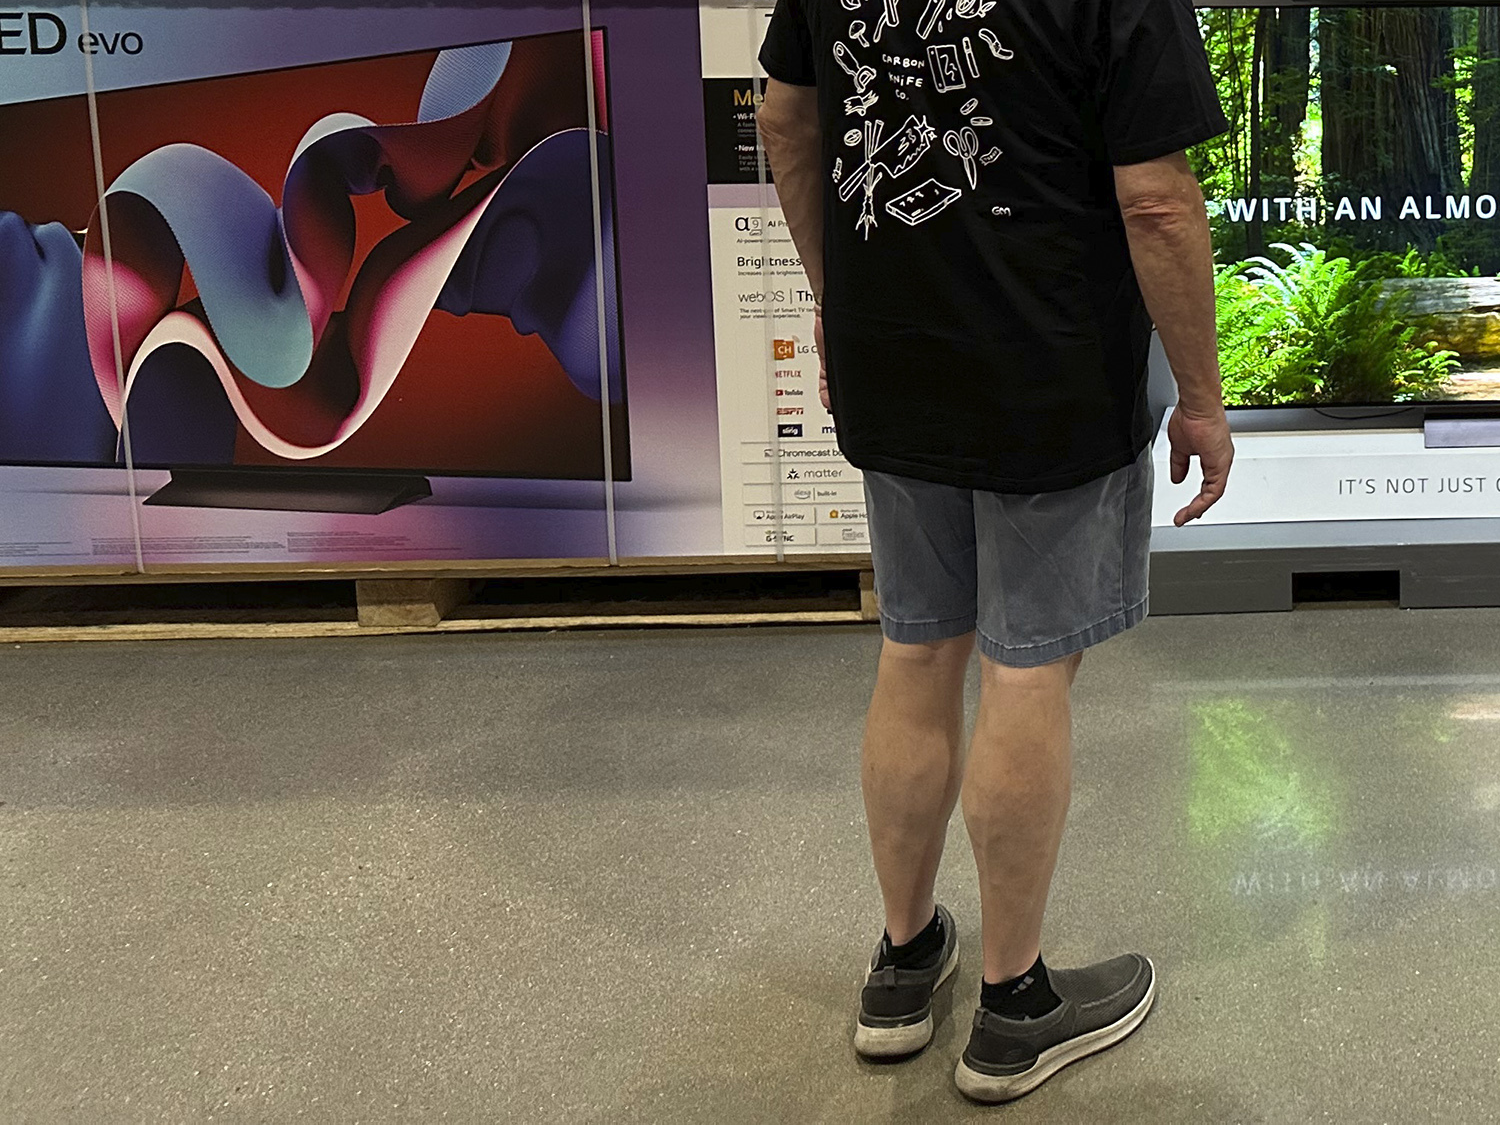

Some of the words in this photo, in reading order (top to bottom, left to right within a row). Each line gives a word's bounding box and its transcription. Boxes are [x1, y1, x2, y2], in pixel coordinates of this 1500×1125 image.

[78, 31, 144, 55] evo
[882, 53, 926, 69] CARBON
[1225, 197, 1317, 223] WITH
[1334, 195, 1382, 221] AN
[738, 289, 785, 303] webOS
[778, 341, 792, 354] CH
[798, 341, 809, 354] LG
[776, 407, 804, 415] ESPN
[804, 469, 843, 478] matter
[1338, 478, 1376, 495] IT'S
[1386, 478, 1428, 495] NOT
[1437, 477, 1487, 494] JUST
